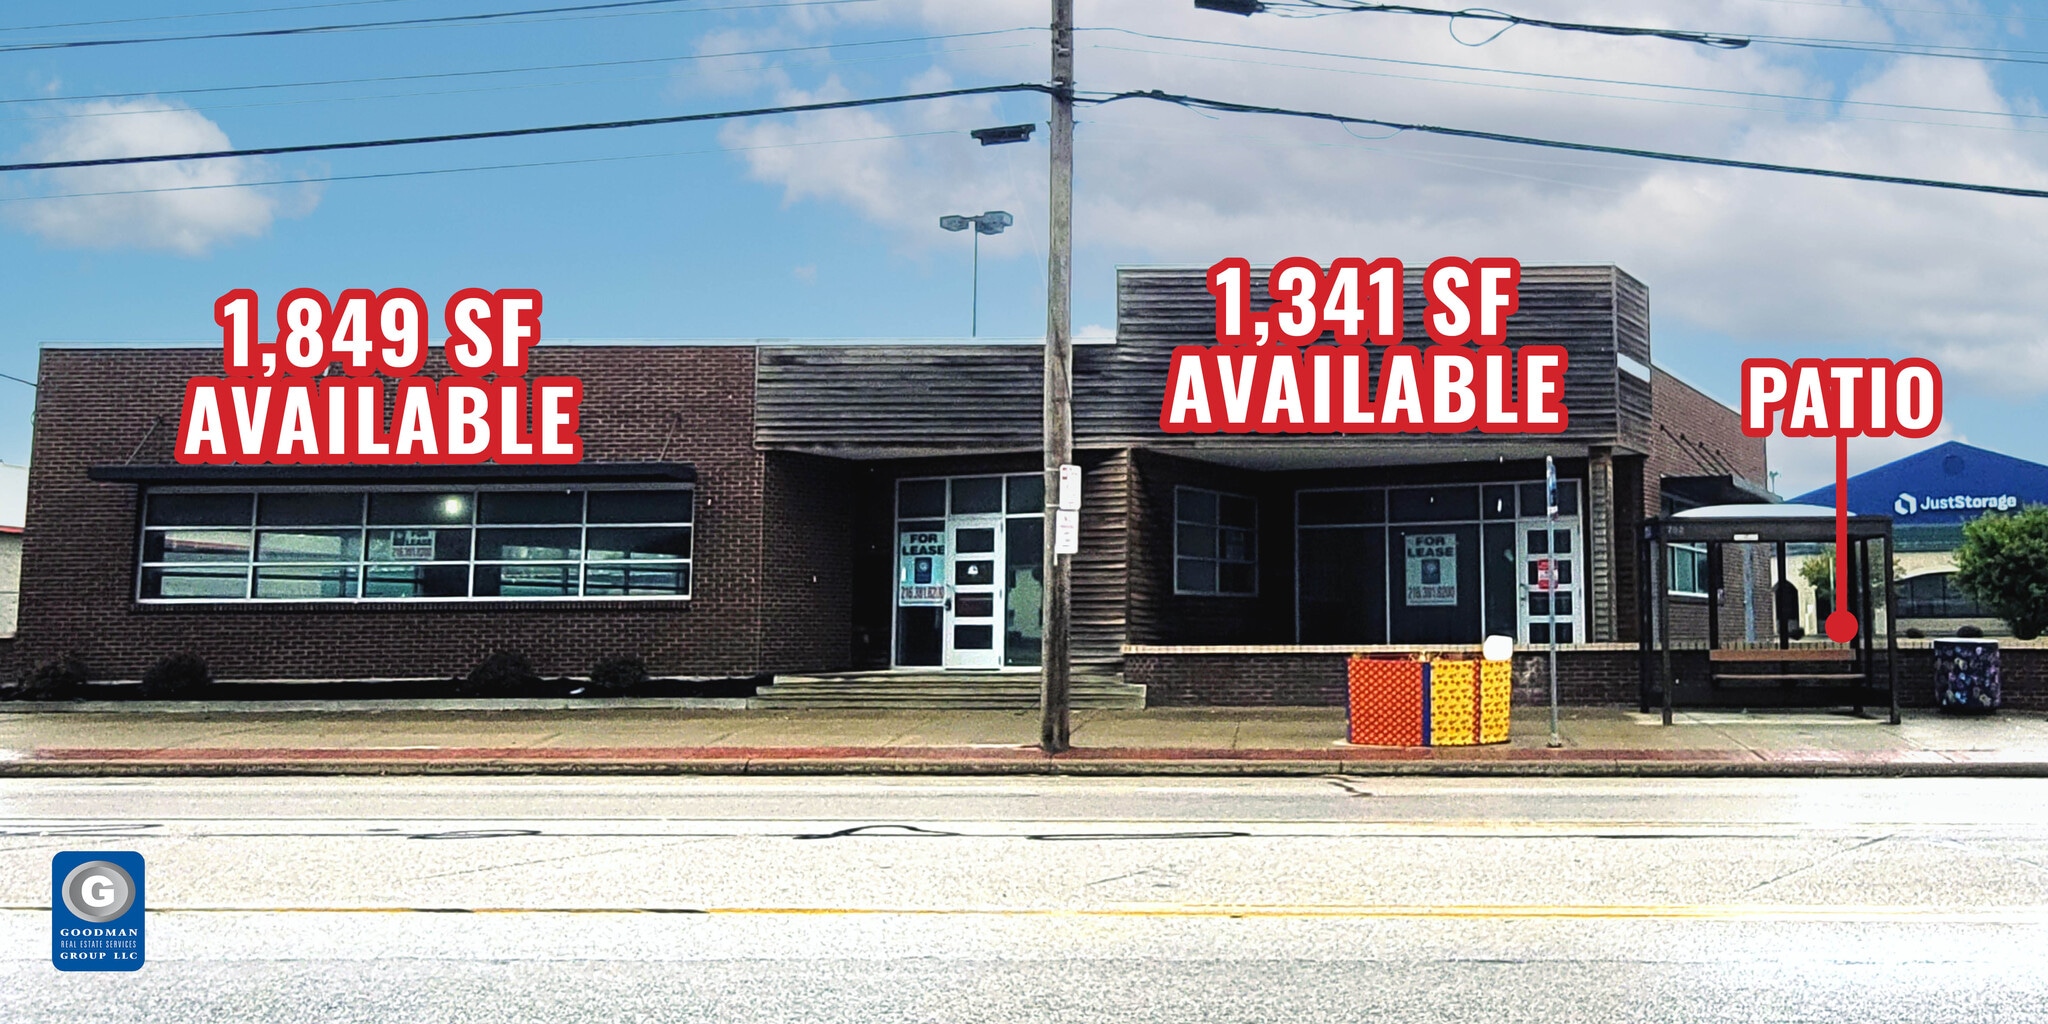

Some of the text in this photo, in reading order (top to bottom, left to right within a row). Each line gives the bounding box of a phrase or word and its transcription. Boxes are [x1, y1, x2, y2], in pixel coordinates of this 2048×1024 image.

[1920, 494, 2017, 511] JustStorage
[909, 533, 938, 544] FOR
[1415, 535, 1446, 546] FOR
[902, 544, 945, 556] LEASE
[1407, 547, 1455, 558] LEASE
